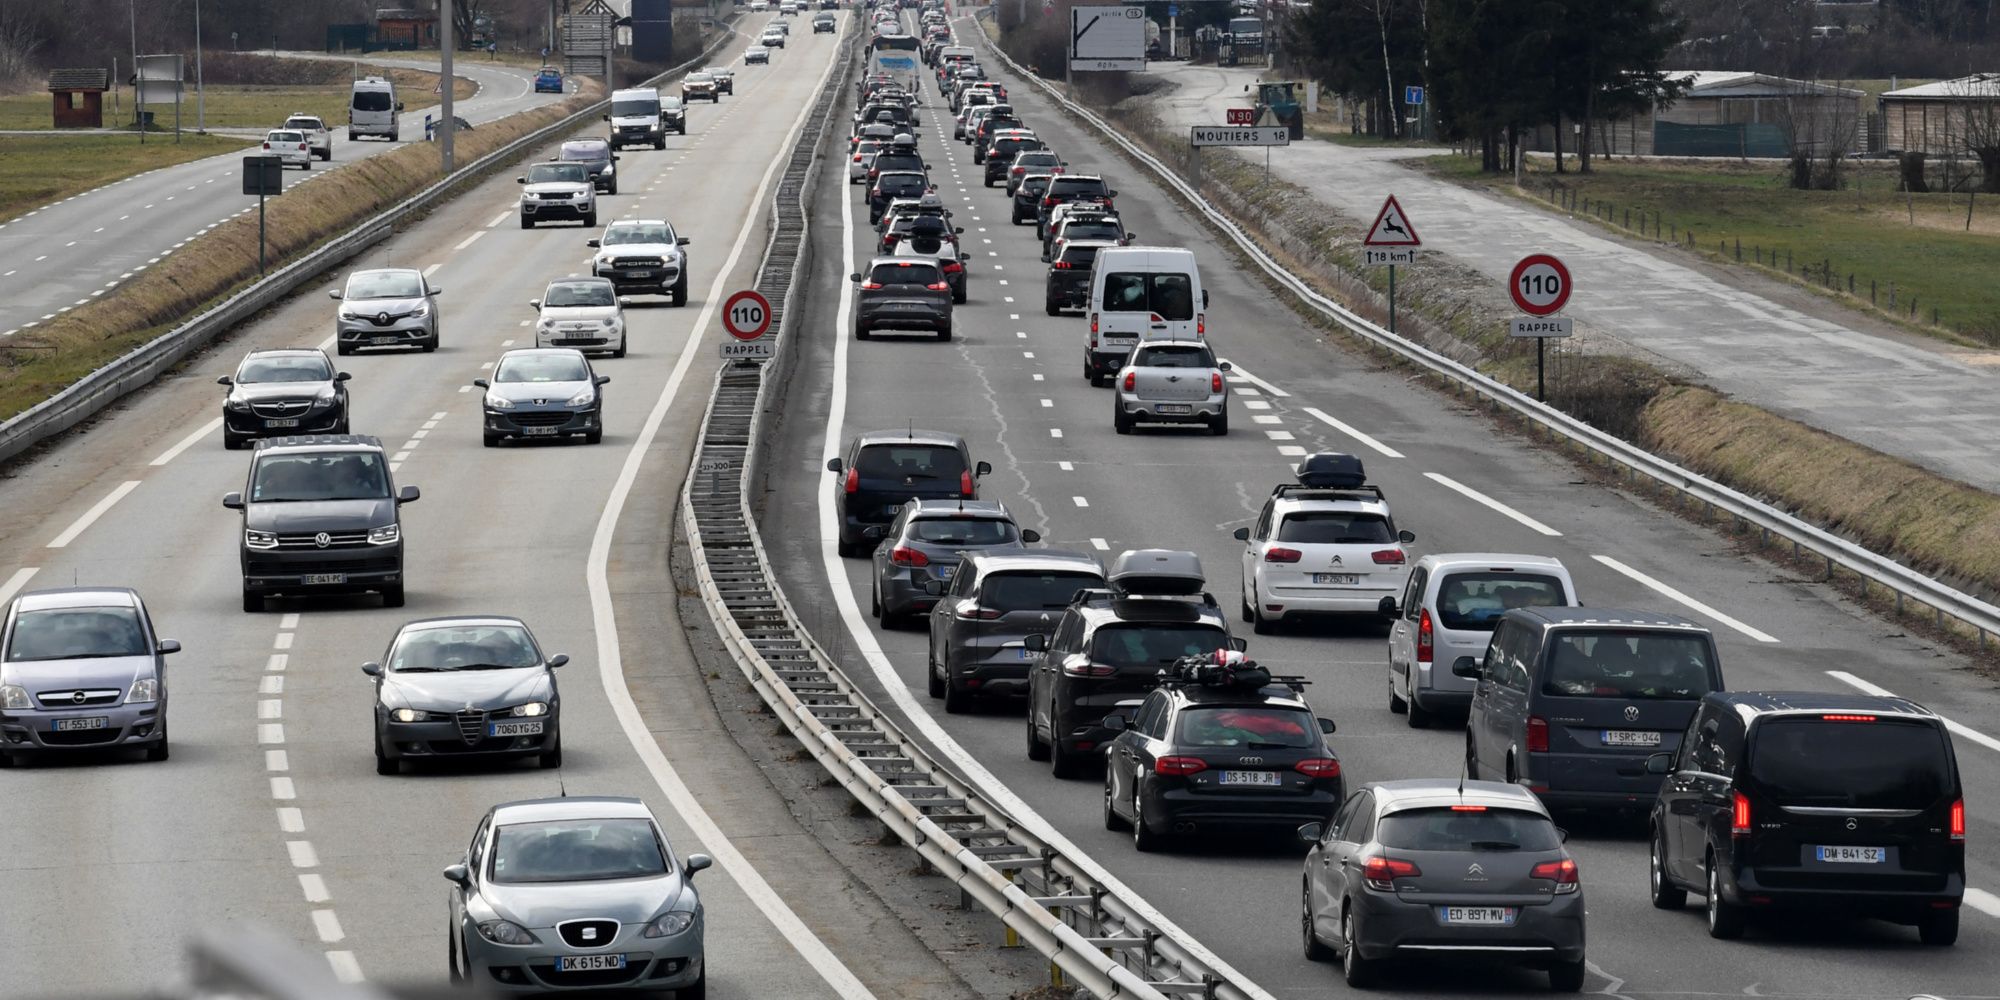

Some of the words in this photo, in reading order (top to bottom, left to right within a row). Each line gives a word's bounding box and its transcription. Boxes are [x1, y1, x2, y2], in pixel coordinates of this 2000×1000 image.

[1228, 112, 1235, 122] N
[1238, 112, 1252, 121] 90
[1196, 132, 1258, 141] MOUTIERS
[1274, 132, 1285, 140] 18
[1374, 252, 1386, 262] 18
[1390, 252, 1406, 262] km
[1521, 275, 1559, 295] 110
[732, 307, 762, 323] 110
[1519, 323, 1562, 332] RAPPEL
[726, 346, 768, 354] RAPPEL
[496, 724, 518, 734] 7060
[519, 723, 530, 733] YG
[530, 722, 542, 733] 25
